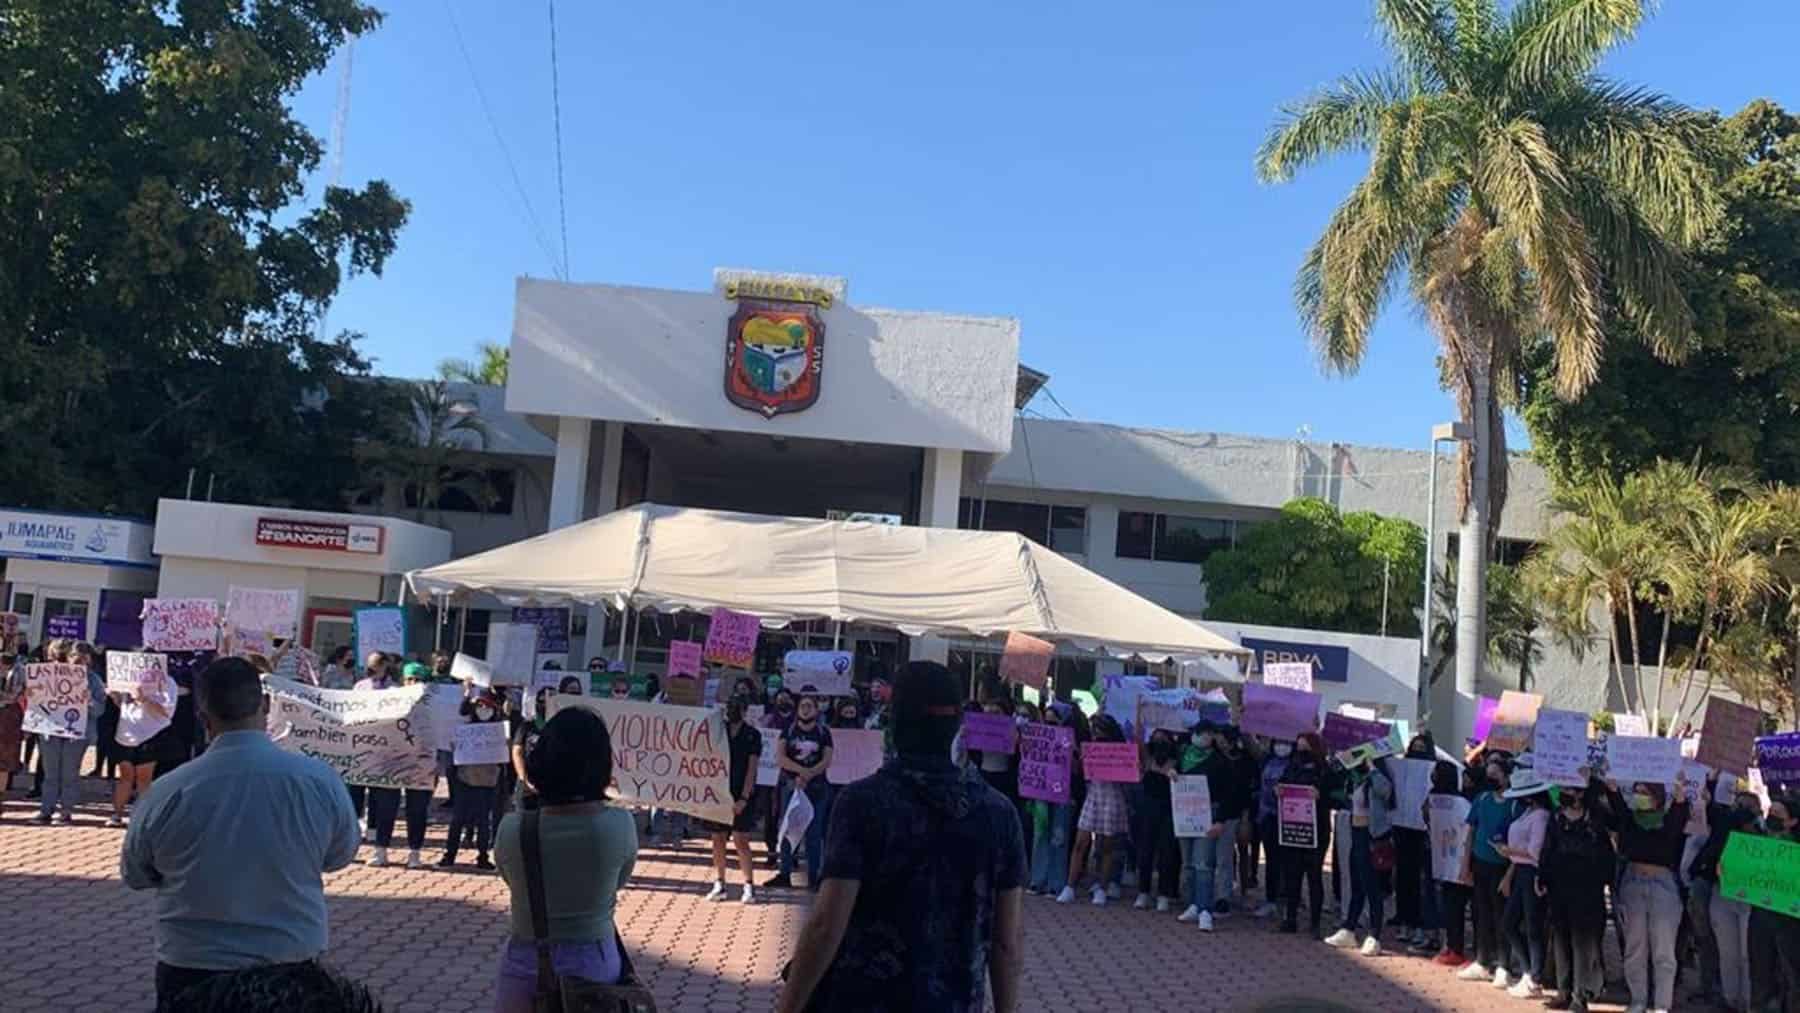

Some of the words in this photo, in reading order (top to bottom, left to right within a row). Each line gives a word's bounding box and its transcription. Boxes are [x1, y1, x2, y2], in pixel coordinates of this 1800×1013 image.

[131, 655, 162, 670] ROPA
[28, 665, 51, 680] LAS
[45, 679, 72, 697] NO
[351, 732, 389, 749] pasa
[677, 756, 728, 779] ACOSA
[631, 776, 648, 798] Y
[651, 782, 720, 805] VIOLA
